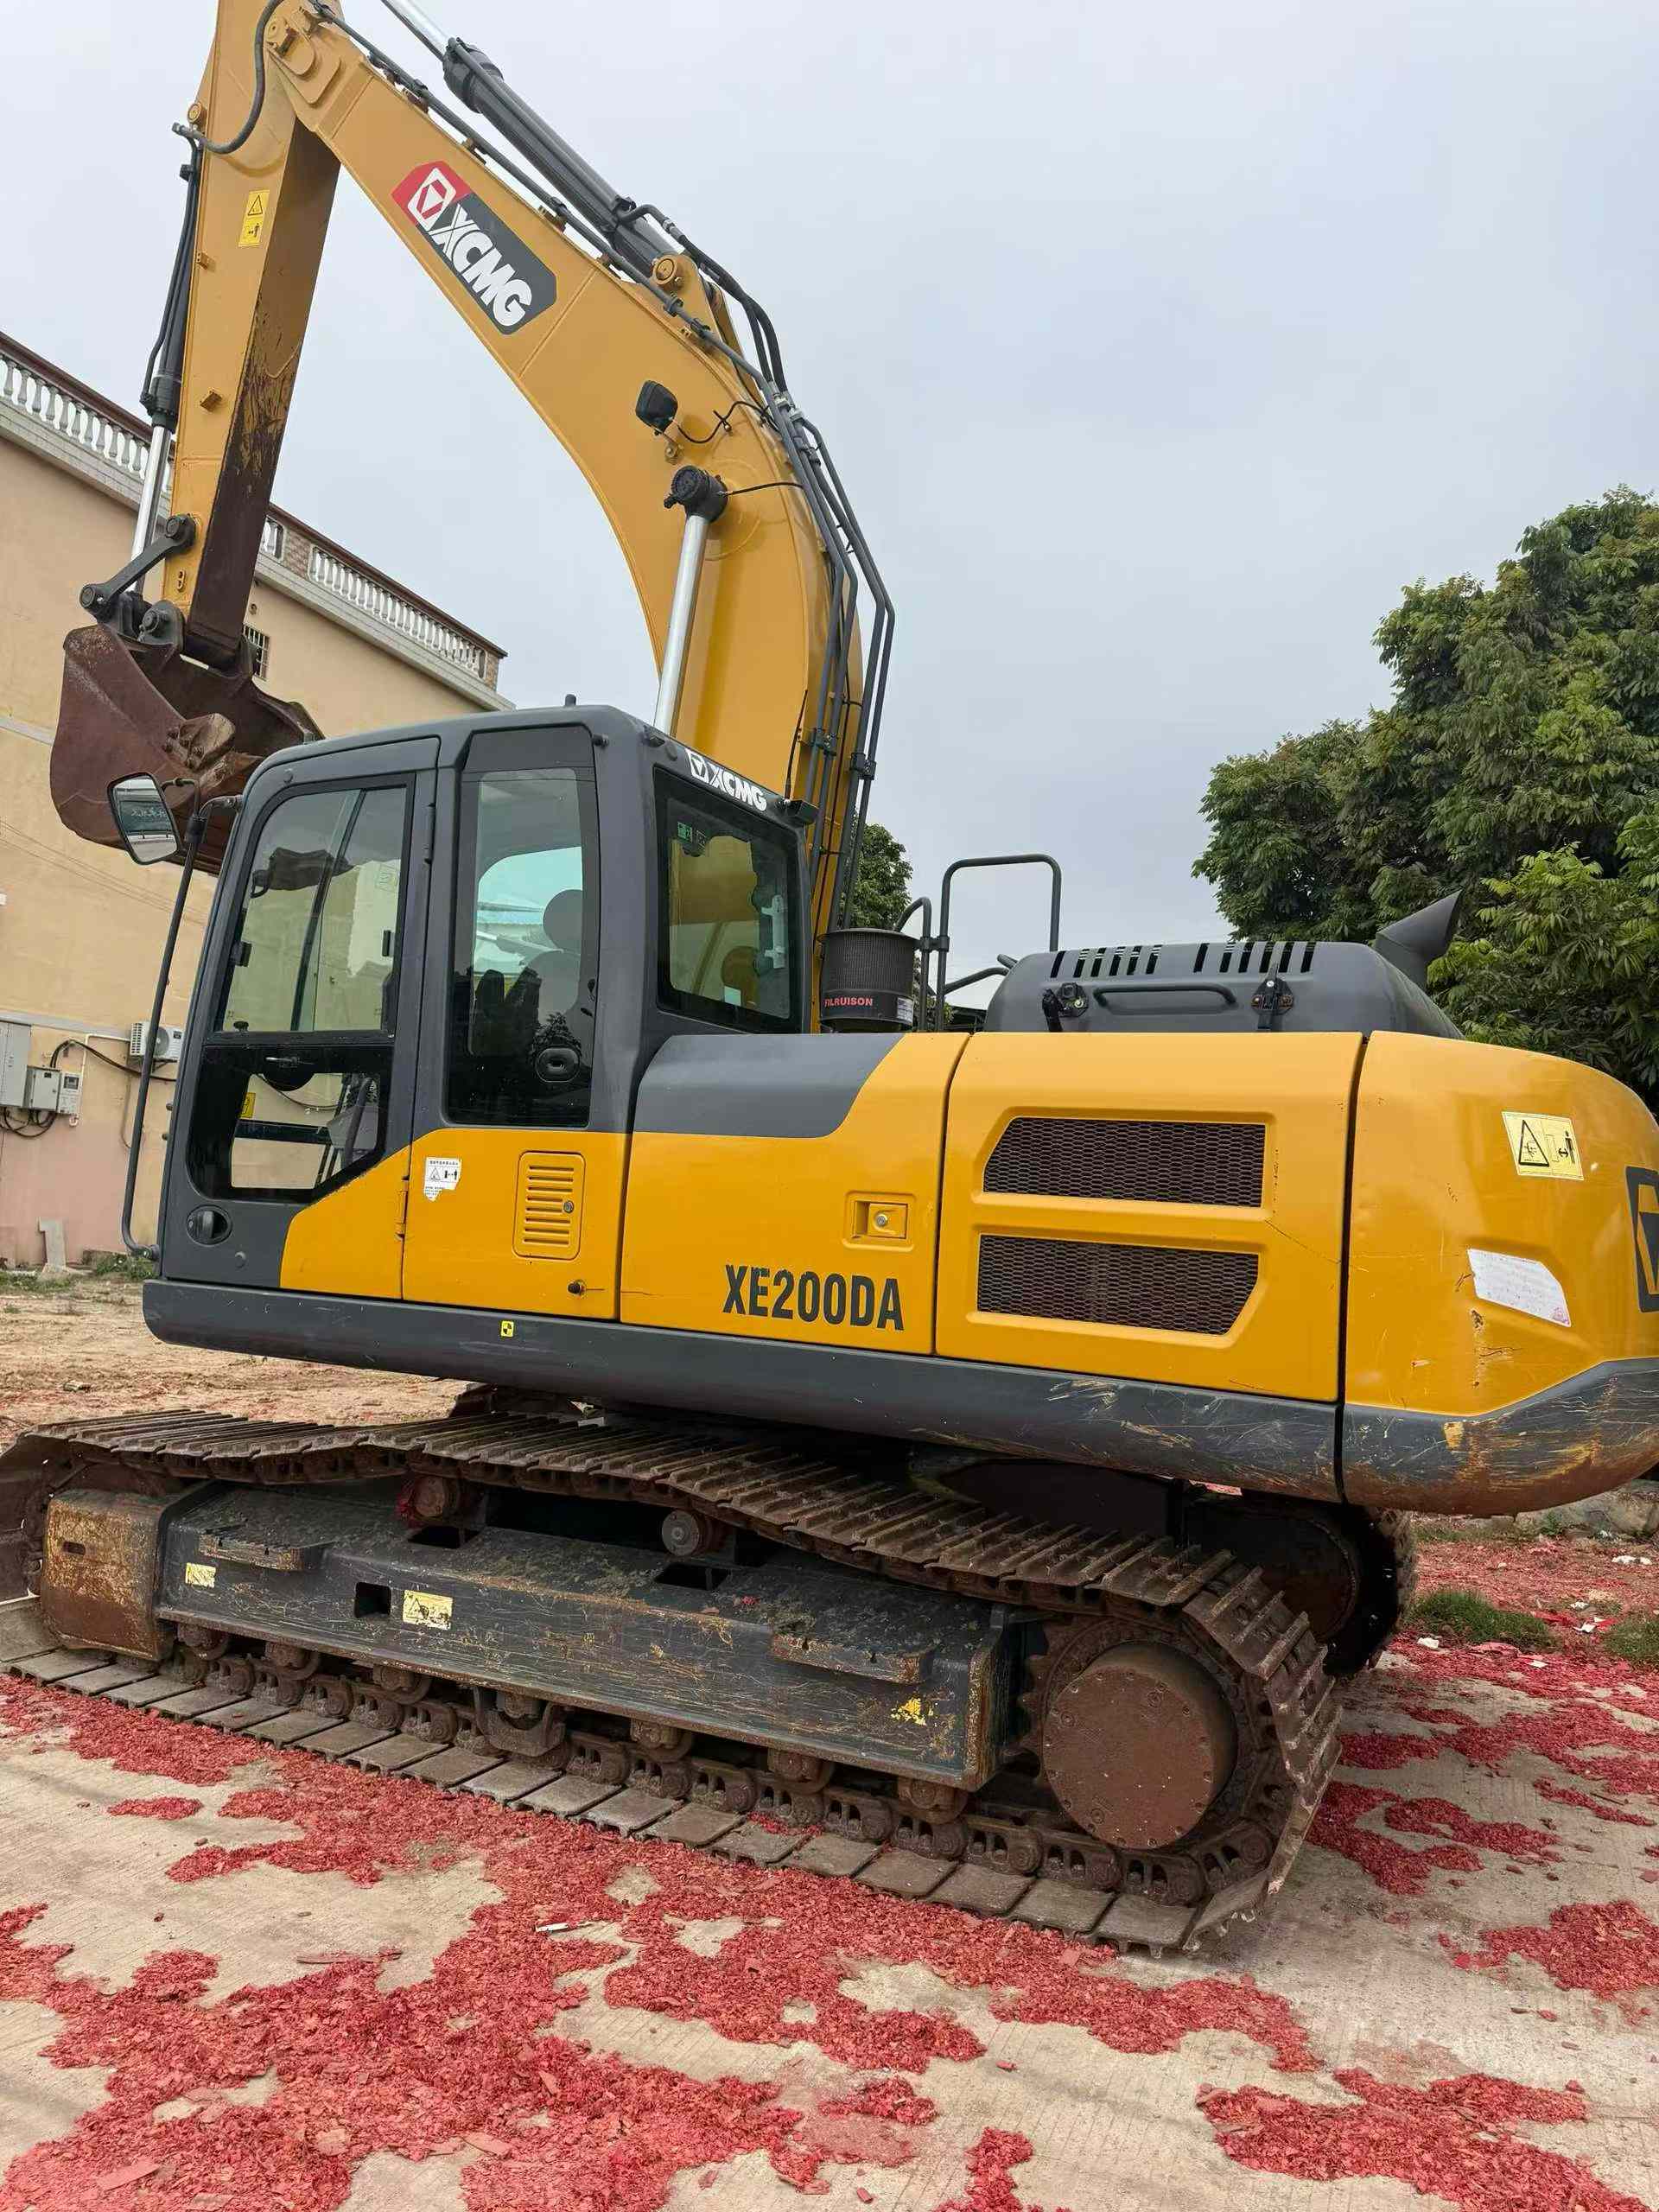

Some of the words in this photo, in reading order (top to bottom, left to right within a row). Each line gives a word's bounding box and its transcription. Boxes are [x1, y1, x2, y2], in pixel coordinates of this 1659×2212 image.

[428, 203, 532, 327] XCMG
[707, 761, 767, 811] XCMG
[722, 1264, 905, 1332] XE200DA
